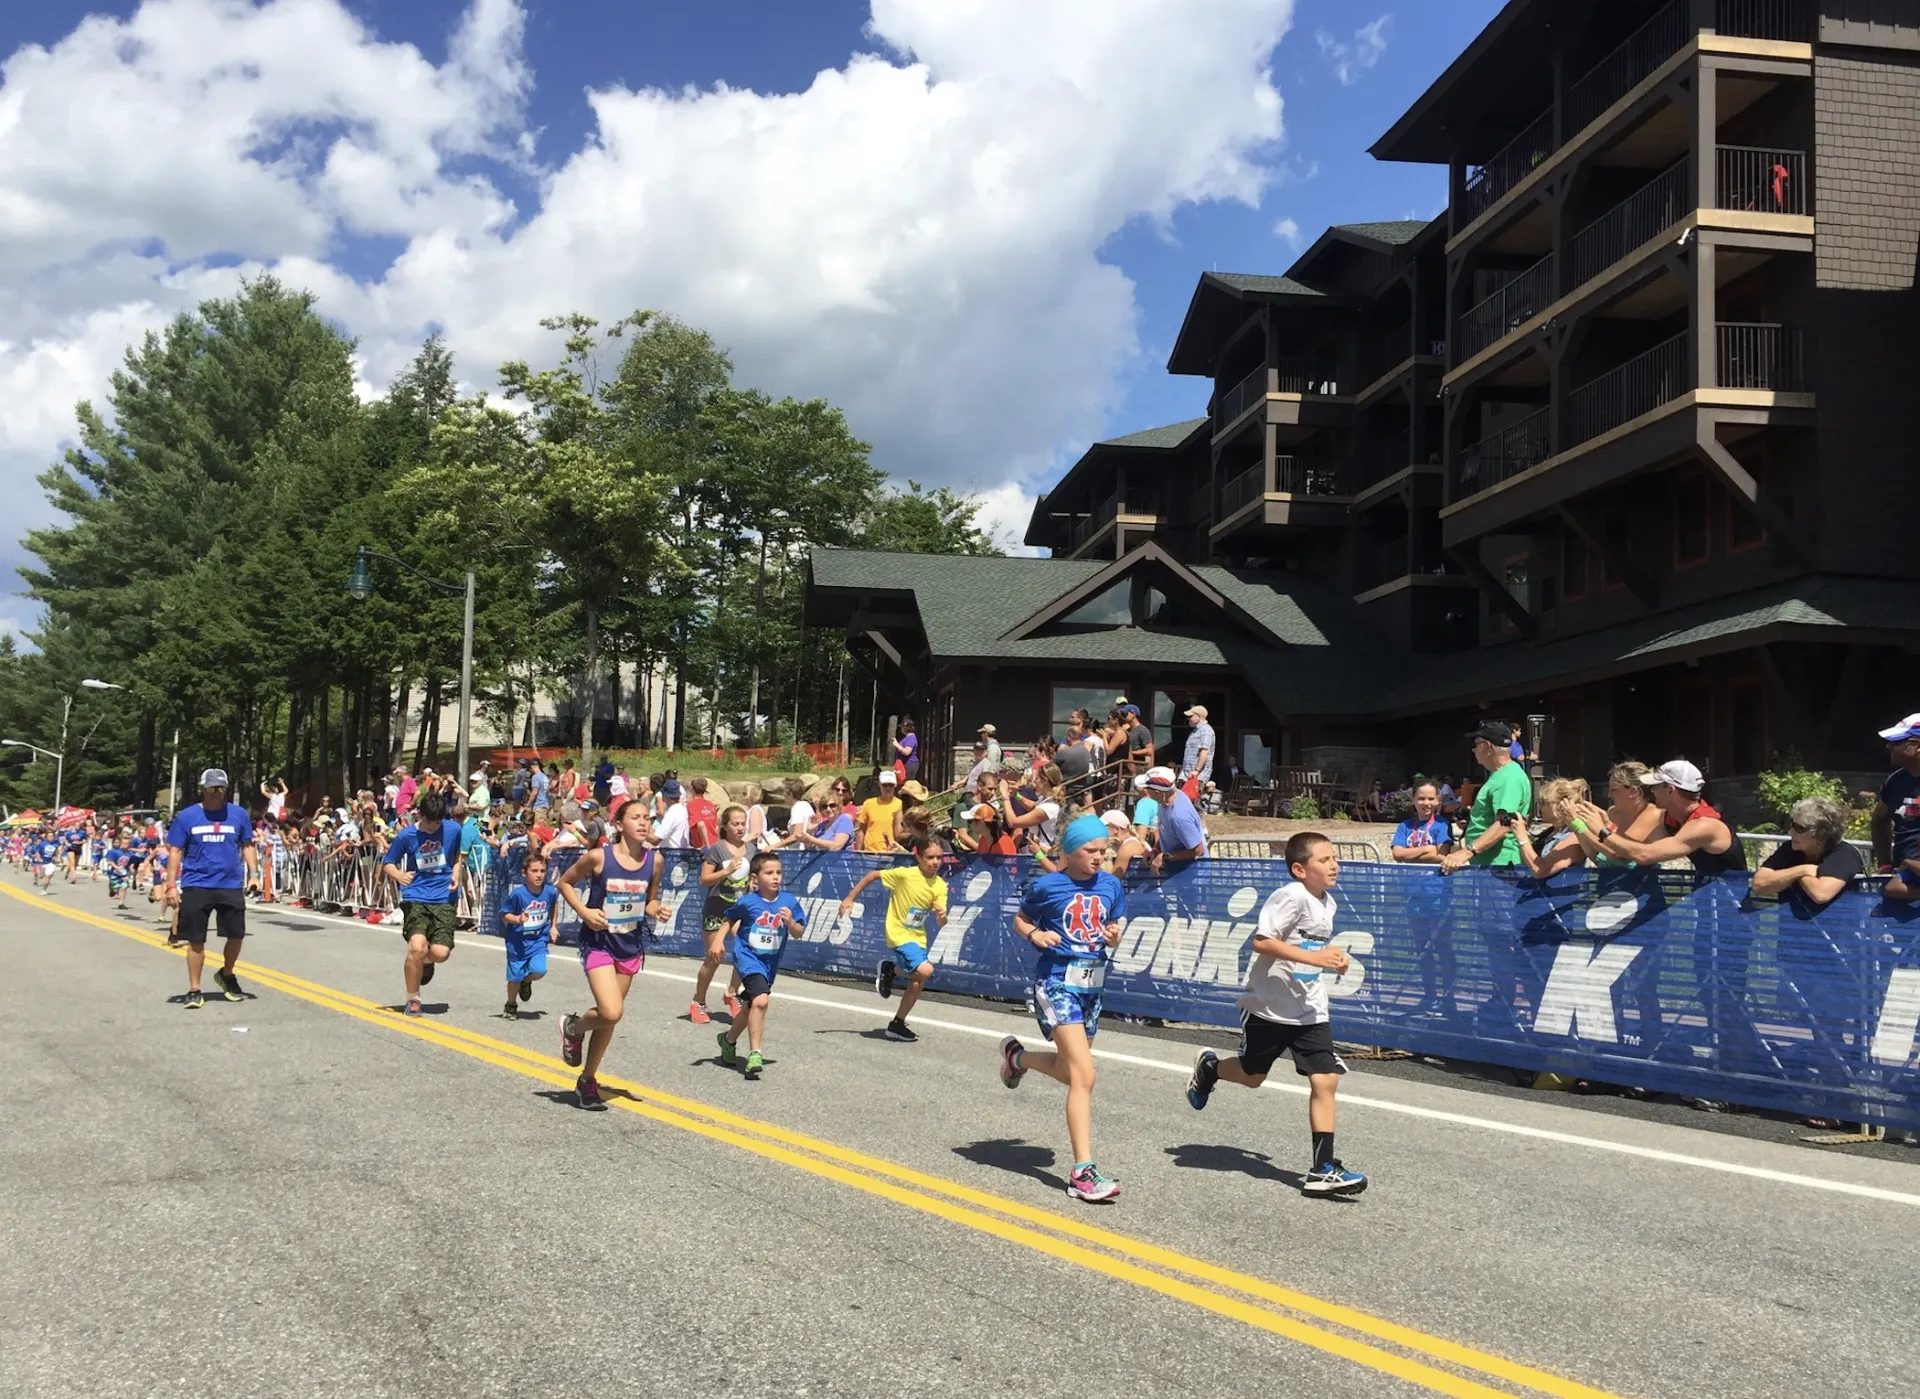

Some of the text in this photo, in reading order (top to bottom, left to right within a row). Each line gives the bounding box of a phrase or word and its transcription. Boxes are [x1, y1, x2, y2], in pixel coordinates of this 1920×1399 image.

[619, 904, 633, 912] 39
[760, 936, 772, 944] 55
[928, 905, 984, 966] K
[1533, 941, 1644, 1047] K TM
